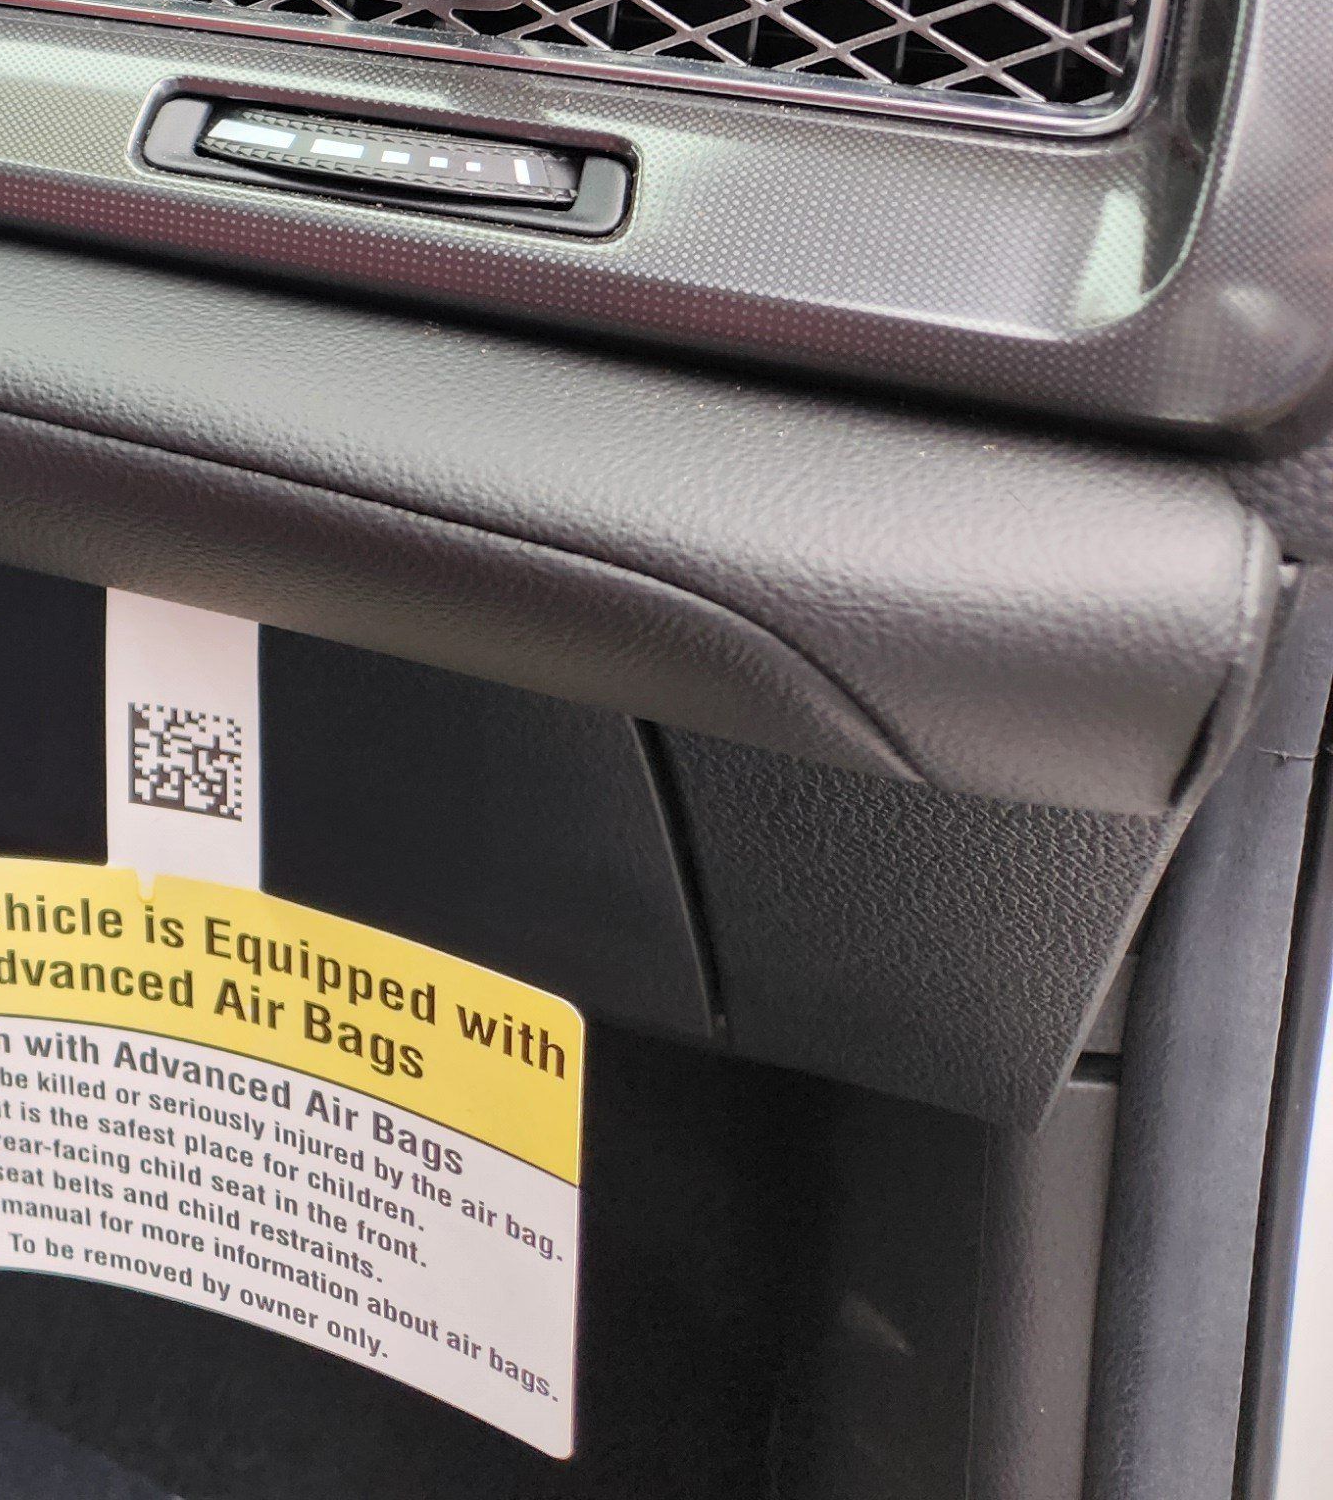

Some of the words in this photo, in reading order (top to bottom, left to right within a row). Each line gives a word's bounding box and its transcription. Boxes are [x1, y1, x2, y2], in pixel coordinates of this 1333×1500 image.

[144, 904, 184, 949] is
[205, 916, 436, 1026] Equipped
[456, 1004, 565, 1080] with
[213, 979, 285, 1031] Air
[304, 1000, 423, 1079] Bags
[0, 1066, 28, 1089] be
[37, 1071, 106, 1101] killed
[115, 1086, 141, 1109] or
[149, 1095, 265, 1140] seriously
[274, 1120, 364, 1172] injured
[374, 1156, 404, 1190] by
[411, 1172, 452, 1207] the
[461, 1198, 498, 1228] air
[506, 1213, 563, 1262] bag.
[20, 1101, 41, 1123] is
[49, 1106, 88, 1130] the
[98, 1118, 176, 1148] safest
[184, 1134, 254, 1168] place
[263, 1152, 299, 1182] for
[307, 1171, 424, 1232] children.
[24, 1032, 99, 1065] with
[113, 1041, 291, 1111] Advanced
[305, 1089, 359, 1132] Air
[372, 1110, 463, 1175] Bags
[53, 1170, 114, 1199] belts
[123, 1187, 169, 1211] and
[178, 1198, 240, 1231] child
[250, 1219, 383, 1283] restraints.
[140, 1156, 202, 1187] child
[211, 1175, 266, 1206] seat
[275, 1189, 298, 1217] in
[306, 1201, 348, 1234] the
[356, 1219, 426, 1268] front.
[1, 1198, 91, 1227] manual
[99, 1210, 134, 1235] for
[141, 1223, 205, 1252] more
[214, 1236, 358, 1307] information
[367, 1297, 439, 1342] about
[446, 1331, 482, 1360] air
[489, 1346, 558, 1402] bags.
[8, 1232, 36, 1254] To
[45, 1237, 74, 1260] be
[84, 1248, 192, 1287] removed
[203, 1272, 230, 1302] by
[239, 1289, 319, 1329] owner
[327, 1320, 388, 1358] only.
